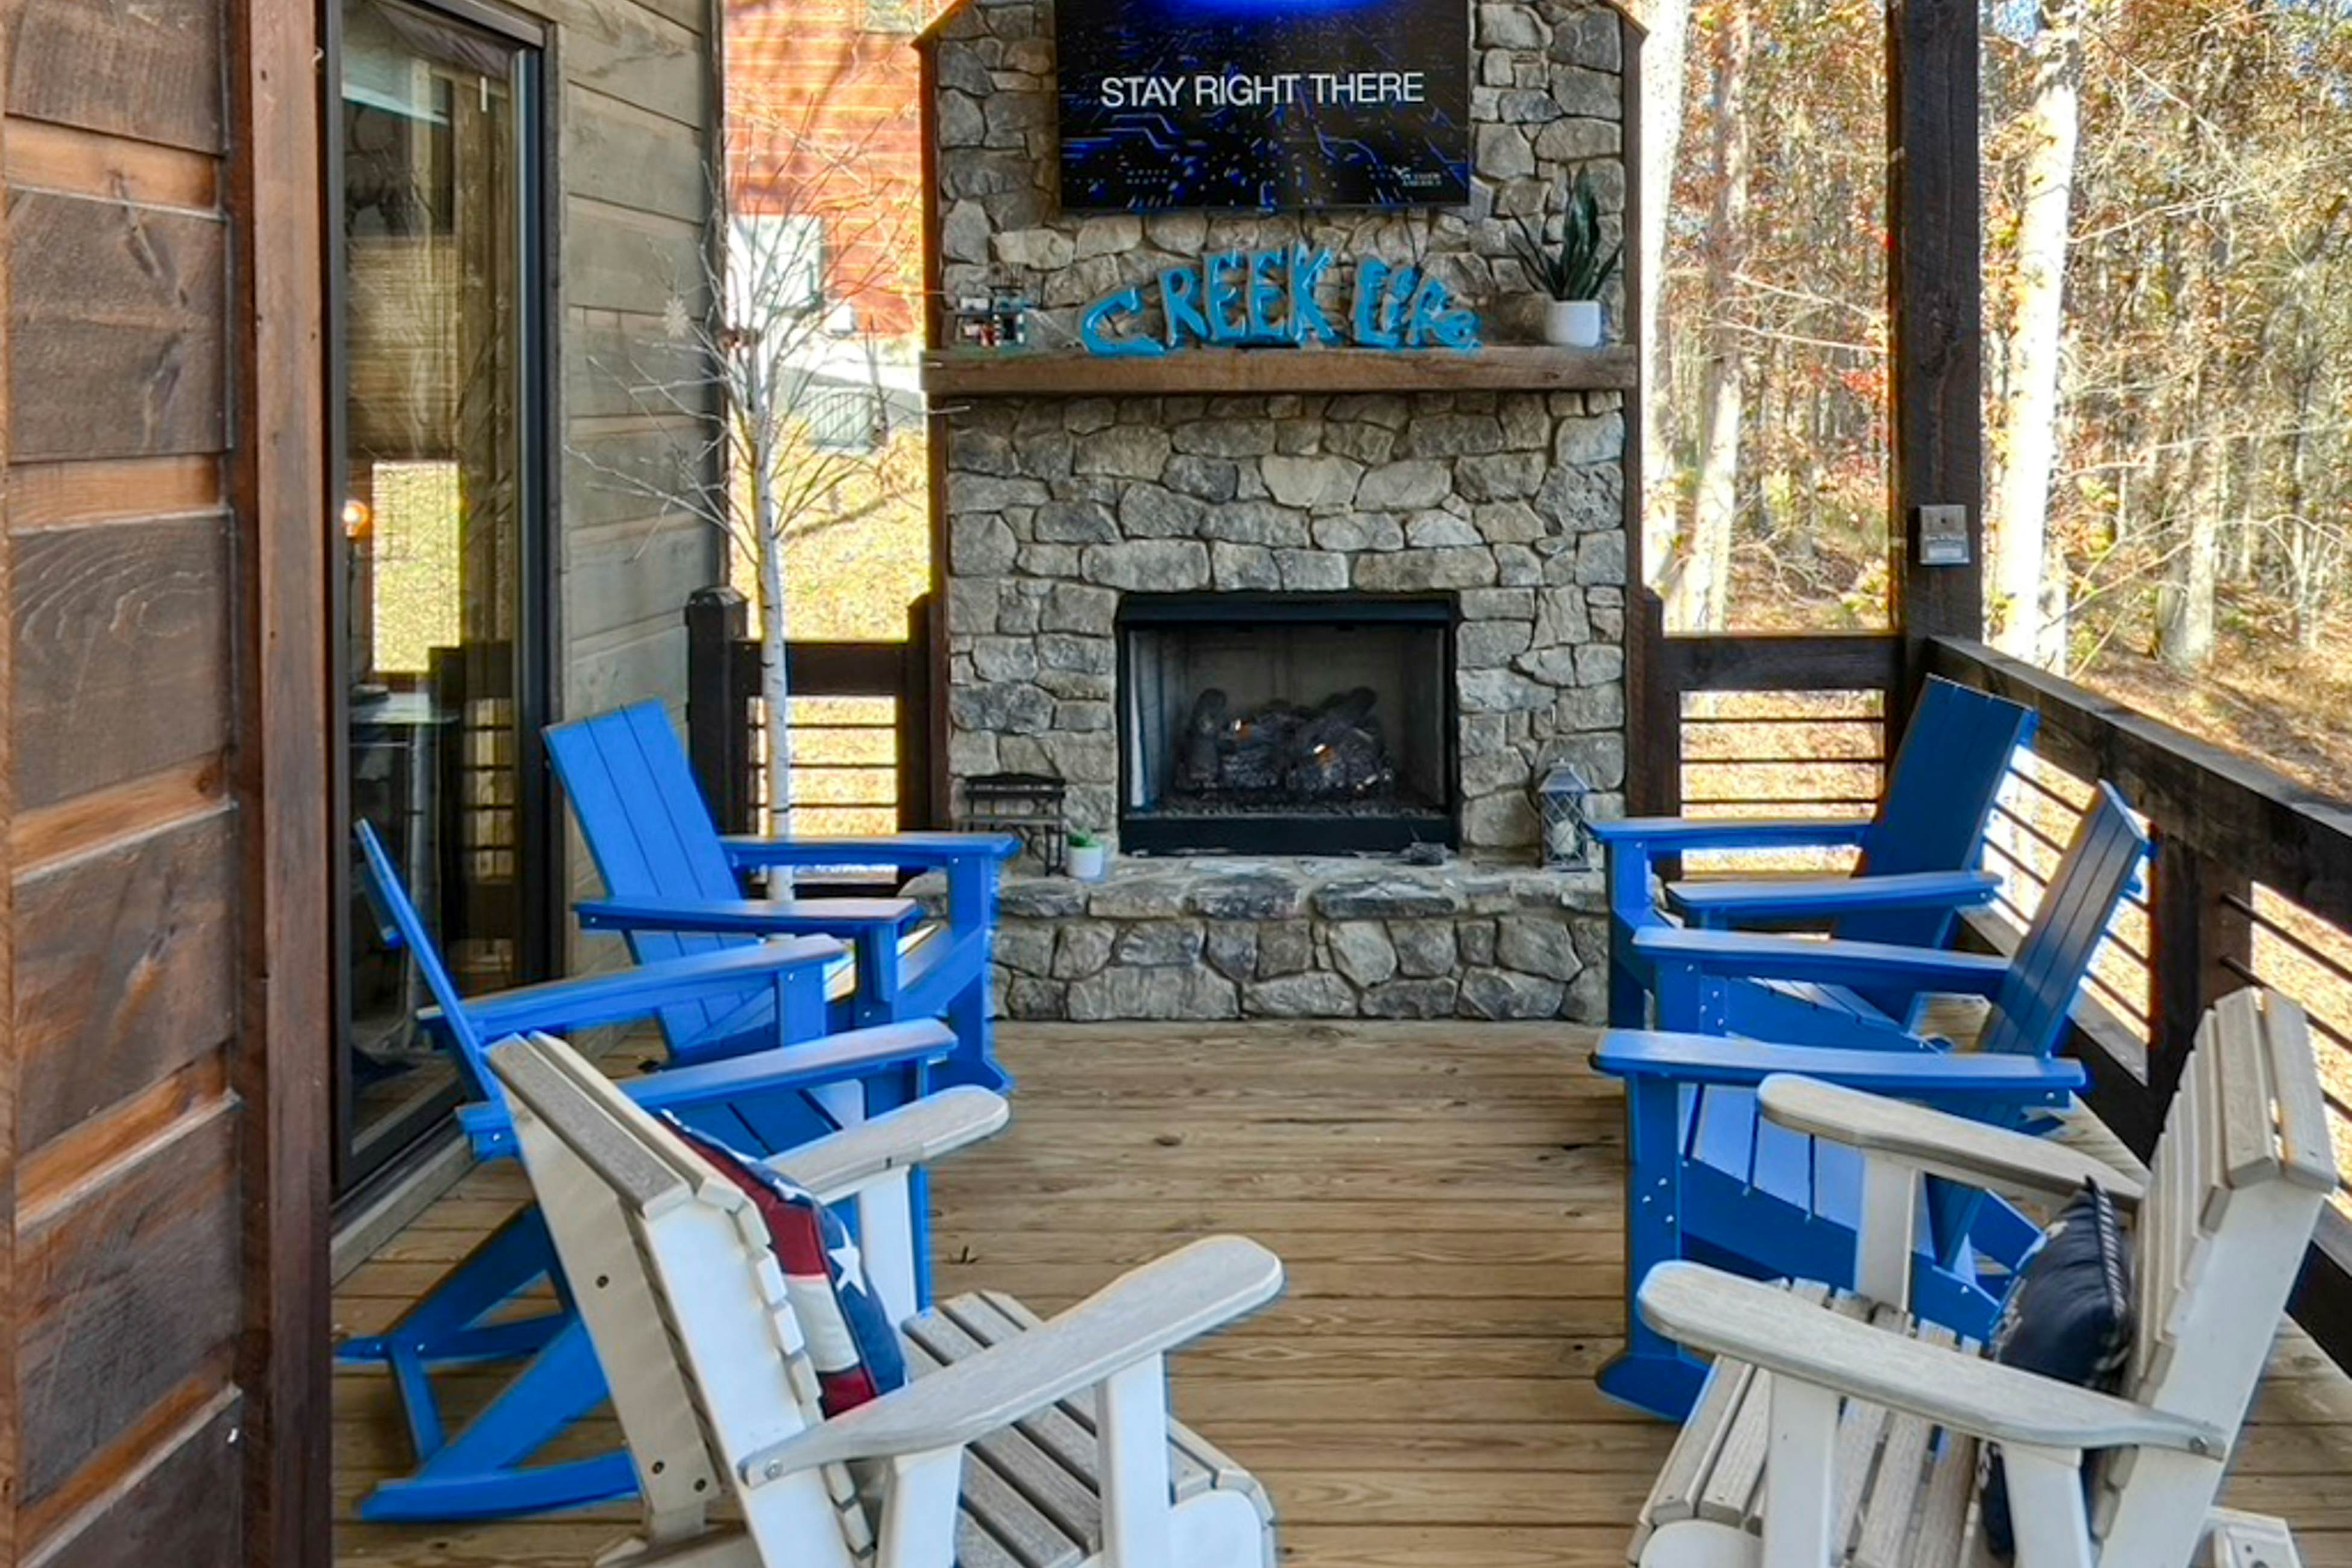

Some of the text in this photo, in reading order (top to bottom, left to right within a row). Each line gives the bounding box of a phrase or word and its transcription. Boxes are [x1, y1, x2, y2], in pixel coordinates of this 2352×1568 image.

[1100, 72, 1425, 107] STAY RIGHT THERE
[1080, 242, 1345, 357] CREEK
